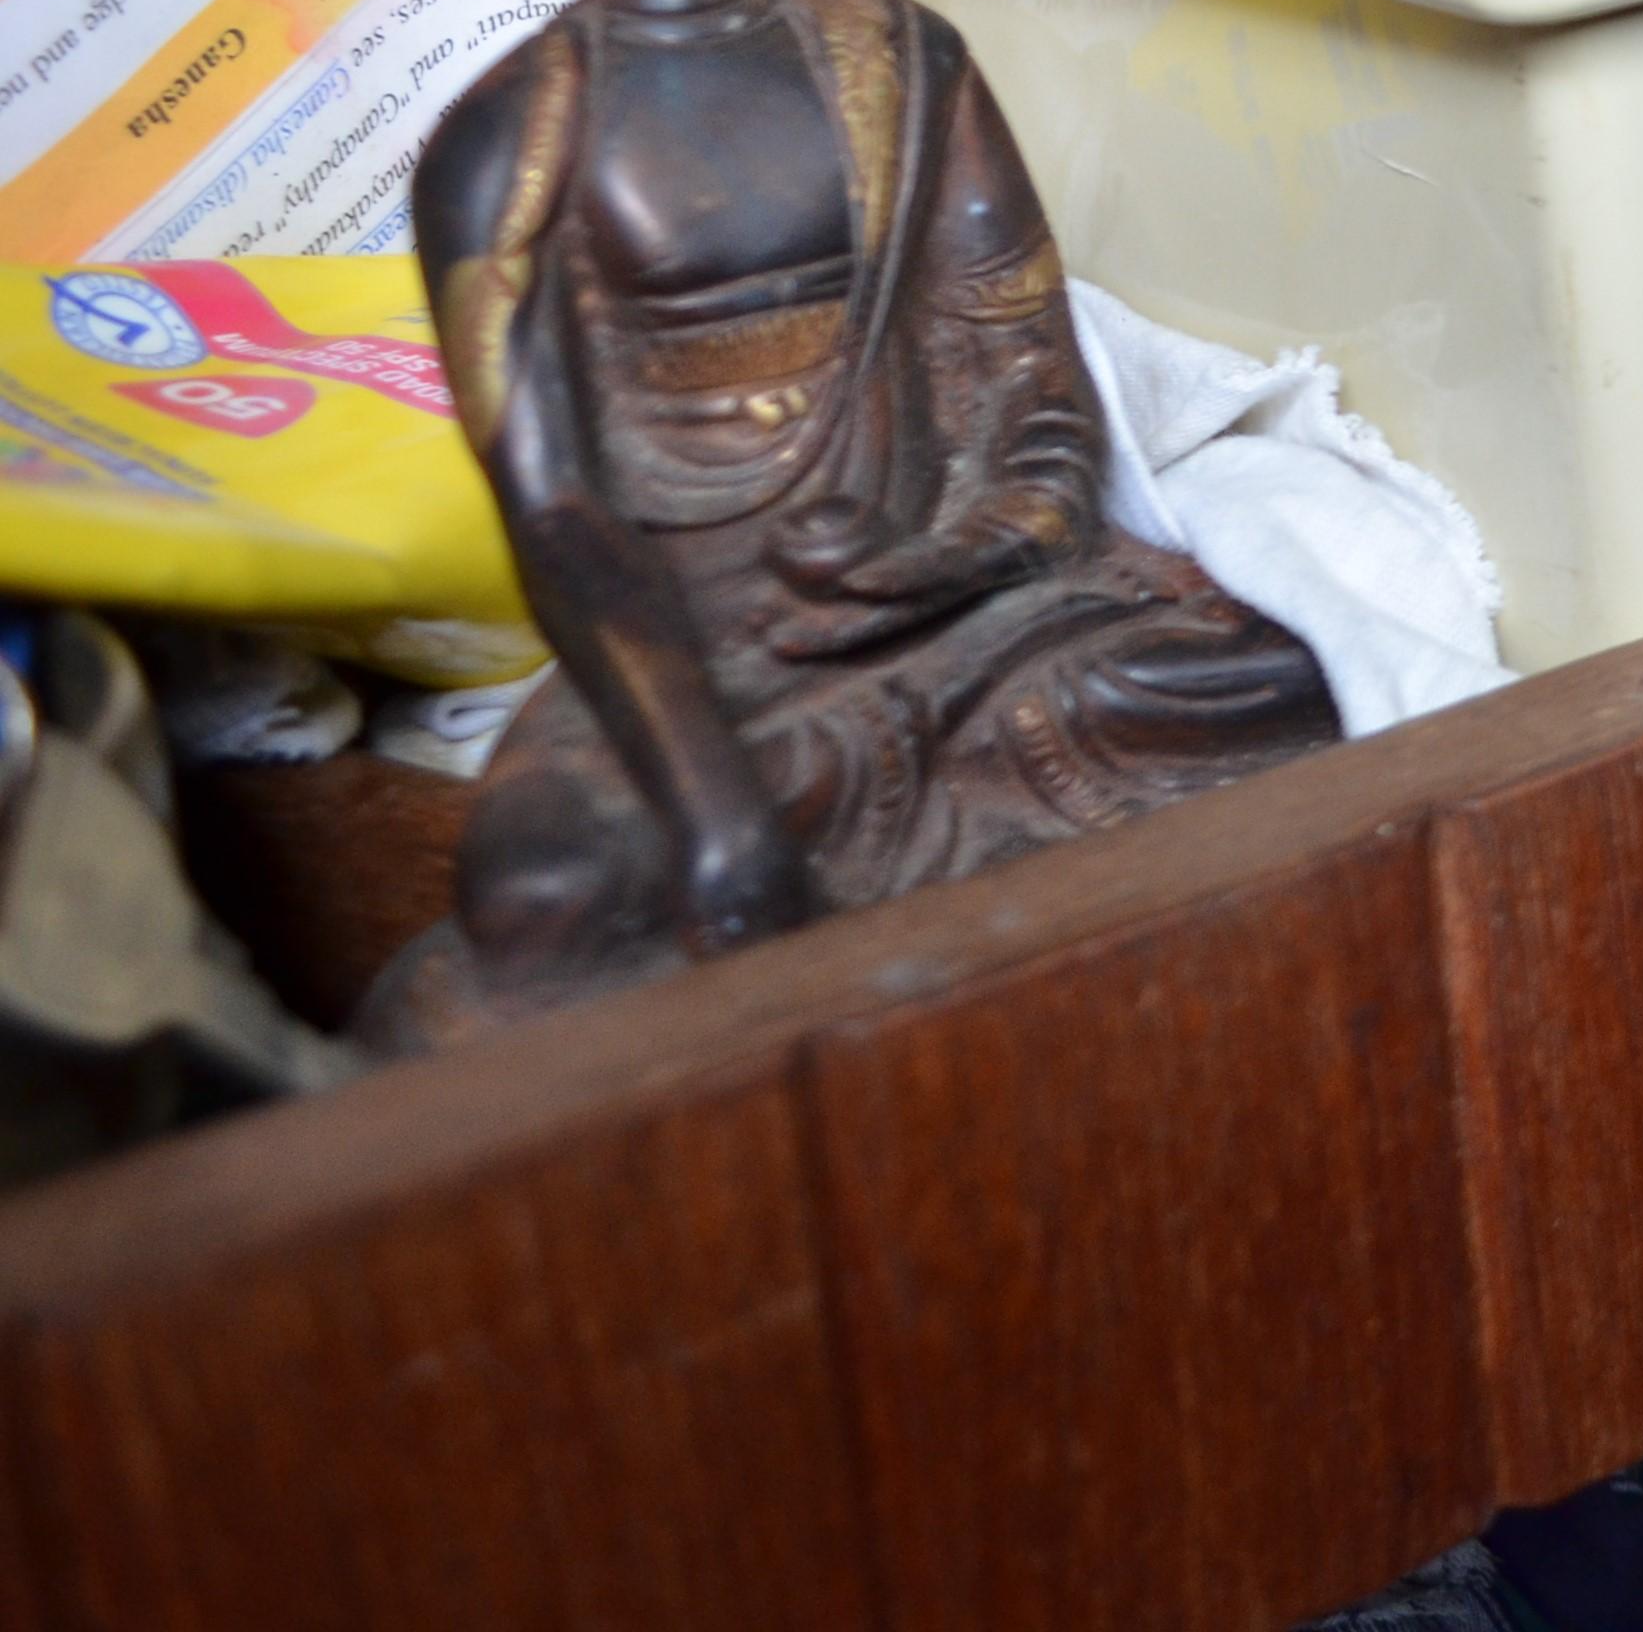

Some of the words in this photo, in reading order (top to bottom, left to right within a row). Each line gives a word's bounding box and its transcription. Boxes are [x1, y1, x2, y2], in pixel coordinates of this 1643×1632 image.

[30, 28, 81, 84] and
[350, 24, 386, 69] see
[408, 36, 455, 92] and
[126, 27, 247, 140] Ganesha
[252, 64, 352, 168] Ganesha
[374, 349, 441, 373] SPF
[160, 379, 288, 419] 50
